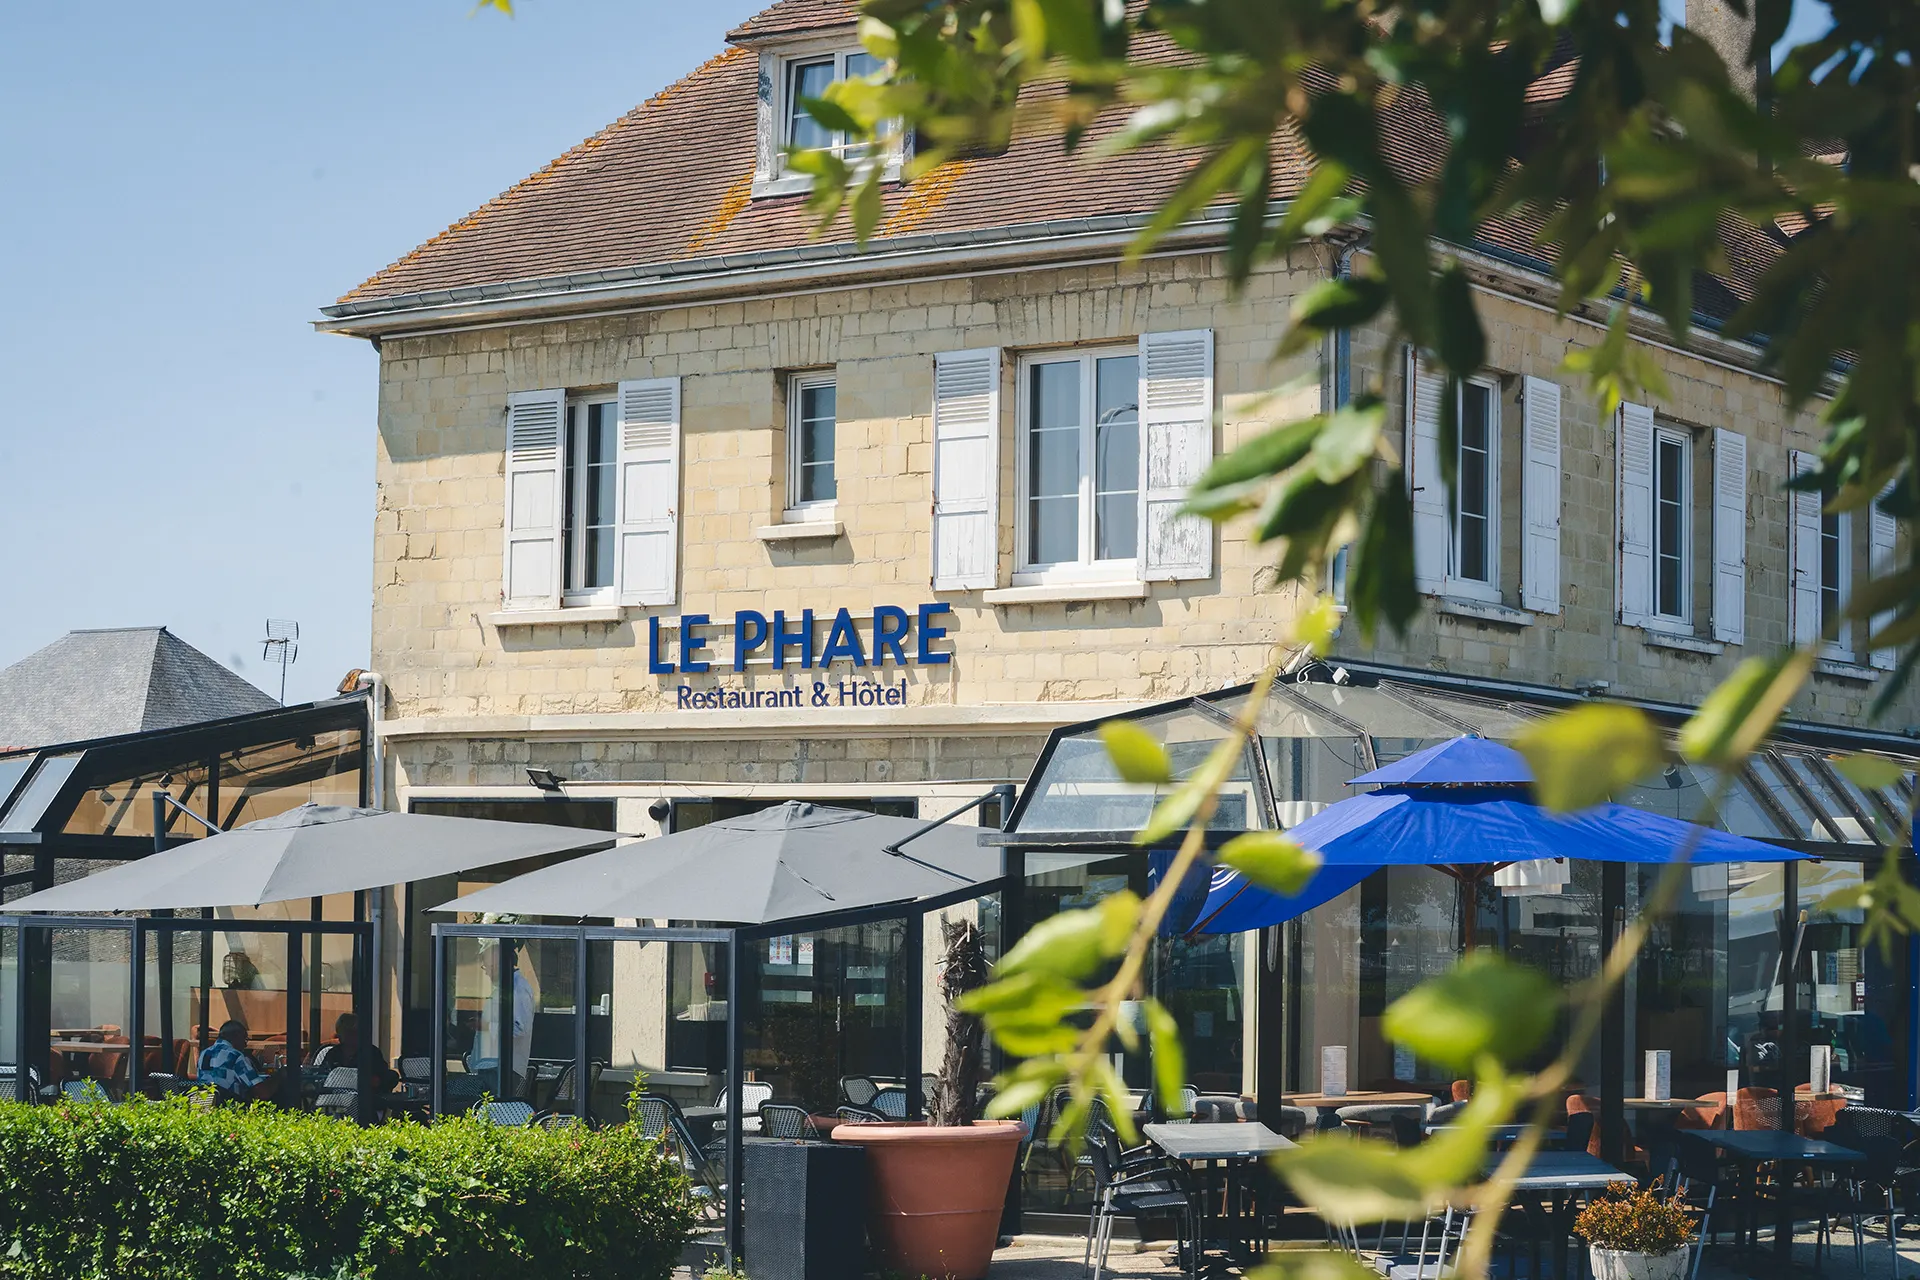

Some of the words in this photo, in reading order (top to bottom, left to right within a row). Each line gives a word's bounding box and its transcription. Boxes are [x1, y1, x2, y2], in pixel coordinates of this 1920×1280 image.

[649, 614, 710, 674] LE
[734, 602, 950, 672] PHARE
[677, 684, 803, 710] Restaurant
[811, 681, 830, 706] &
[839, 678, 907, 707] Hôtel
